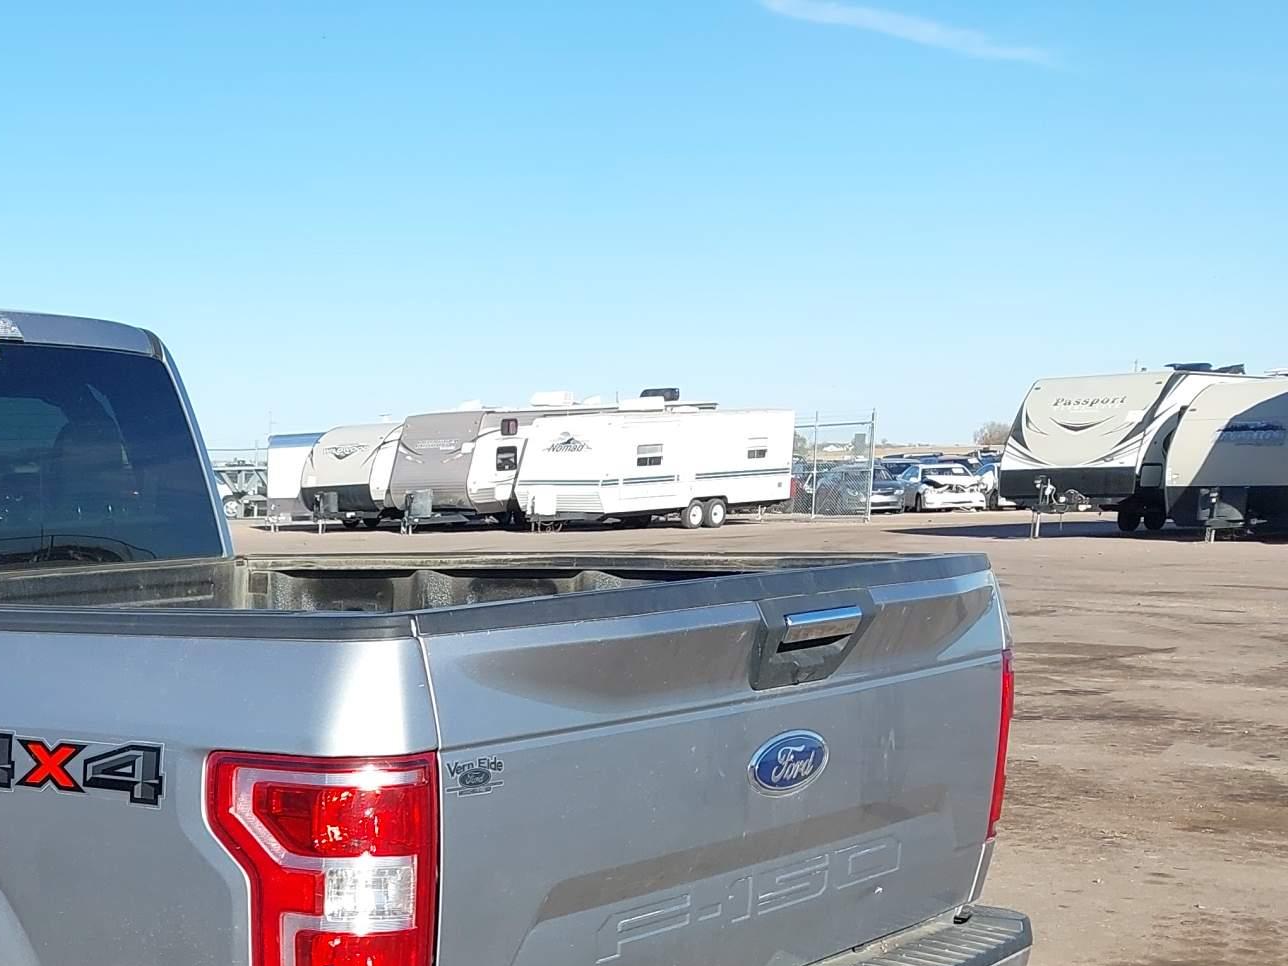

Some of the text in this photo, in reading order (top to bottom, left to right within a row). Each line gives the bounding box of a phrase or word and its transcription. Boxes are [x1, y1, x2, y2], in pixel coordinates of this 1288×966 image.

[1053, 395, 1127, 407] Passport
[546, 442, 585, 453] Nomad
[446, 761, 474, 778] Vern
[771, 744, 816, 783] Ford
[596, 836, 901, 964] F-150
